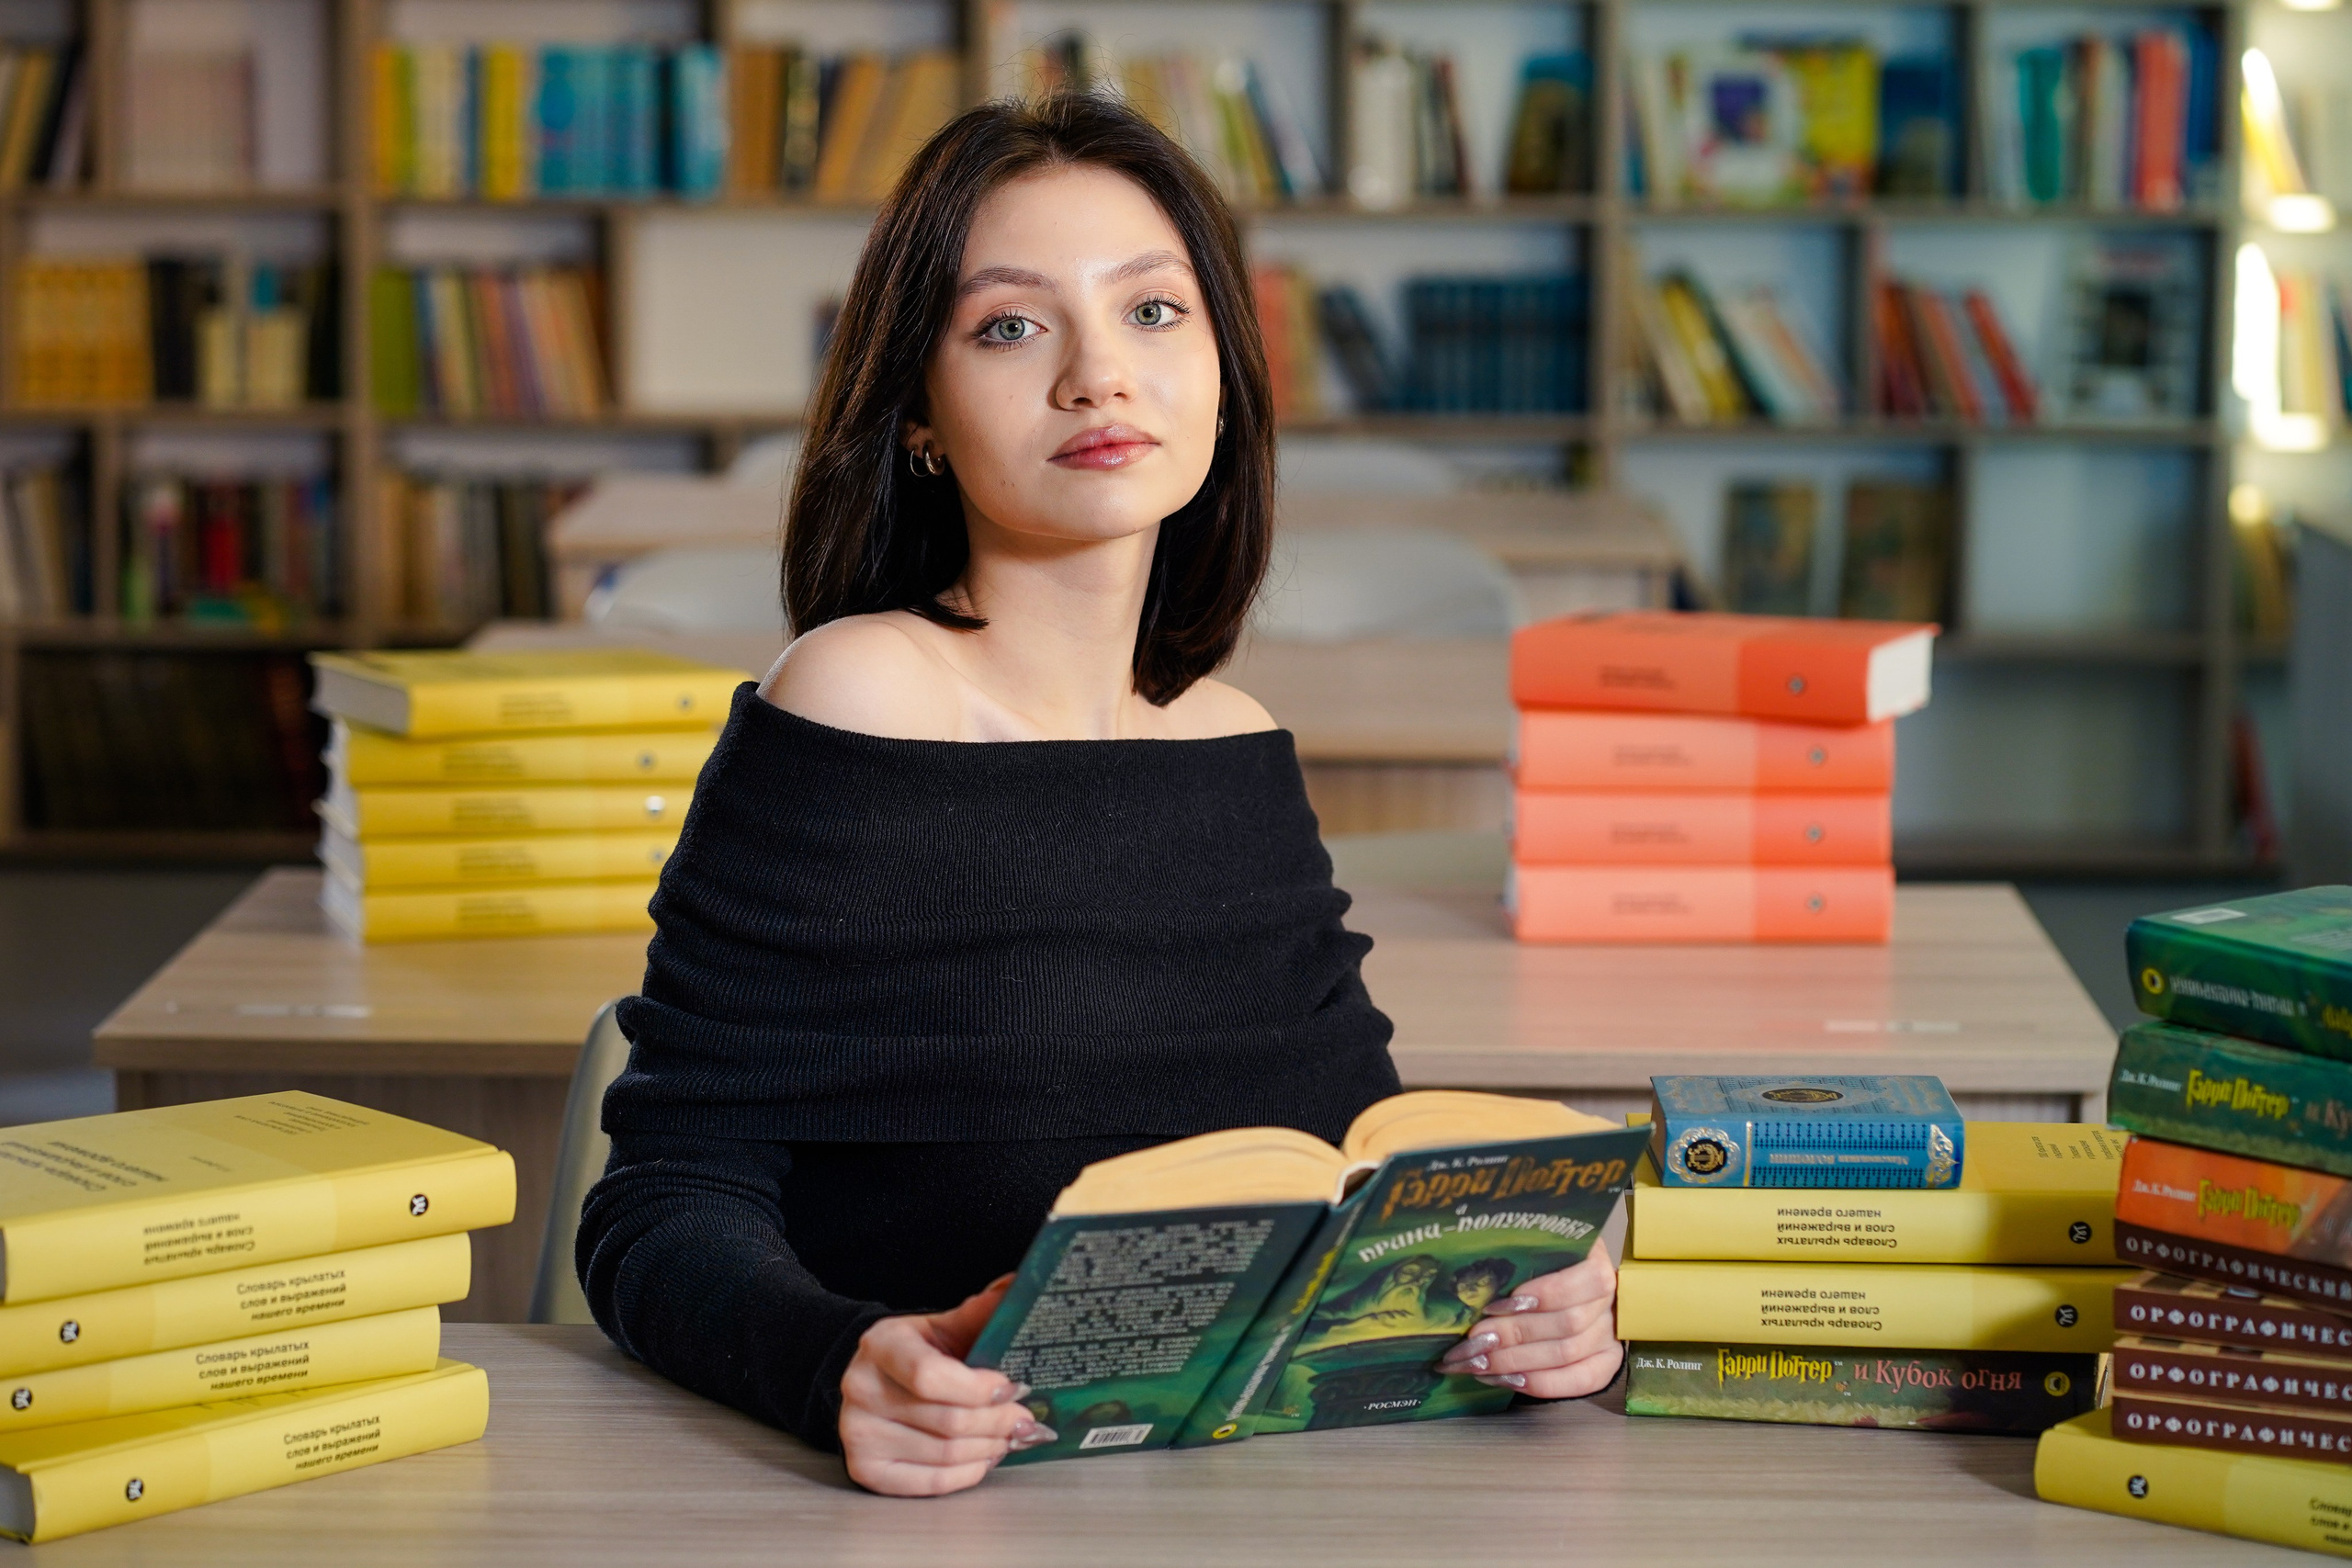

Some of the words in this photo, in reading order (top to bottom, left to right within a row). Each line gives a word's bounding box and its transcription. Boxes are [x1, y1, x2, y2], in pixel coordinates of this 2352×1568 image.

[1777, 1207, 1833, 1217] времени
[1836, 1209, 1882, 1218] нашего
[1777, 1222, 1851, 1233] выражений
[1854, 1224, 1862, 1232] и
[1865, 1224, 1895, 1233] слов
[1777, 1235, 1840, 1246] крылатых
[1843, 1236, 1897, 1248] Словарь
[237, 1280, 287, 1295] Словарь
[288, 1269, 345, 1287] крылатых
[240, 1298, 268, 1310] слов
[280, 1283, 346, 1303] выражений
[1761, 1289, 1816, 1299] времени
[1820, 1291, 1866, 1300] нашего
[251, 1307, 293, 1321] нашего
[295, 1299, 345, 1315] времени
[1761, 1303, 1836, 1314] выражений
[1838, 1305, 1847, 1314] и
[1849, 1305, 1880, 1314] слов
[1761, 1317, 1825, 1327] крылатых
[1828, 1318, 1883, 1331] Словарь
[196, 1350, 247, 1365] Словарь
[250, 1341, 310, 1358] крылатых
[198, 1368, 227, 1380] слов
[241, 1355, 310, 1374] выражений
[1636, 1357, 1654, 1369] Дж.
[1656, 1358, 1666, 1369] К.
[1667, 1359, 1703, 1371] Ролинг
[1717, 1348, 1768, 1391] Гарри
[1769, 1349, 1833, 1384] Поттер
[1854, 1364, 1870, 1380] и
[1875, 1359, 1953, 1394] Кубок
[1962, 1369, 2022, 1391] огня
[210, 1377, 254, 1391] нашего
[256, 1369, 309, 1385] времени
[283, 1429, 328, 1445] Словарь
[329, 1415, 380, 1435] крылатых
[286, 1447, 311, 1460] слов
[322, 1428, 381, 1451] выражений
[295, 1455, 333, 1471] нашего
[334, 1444, 379, 1462] времени
